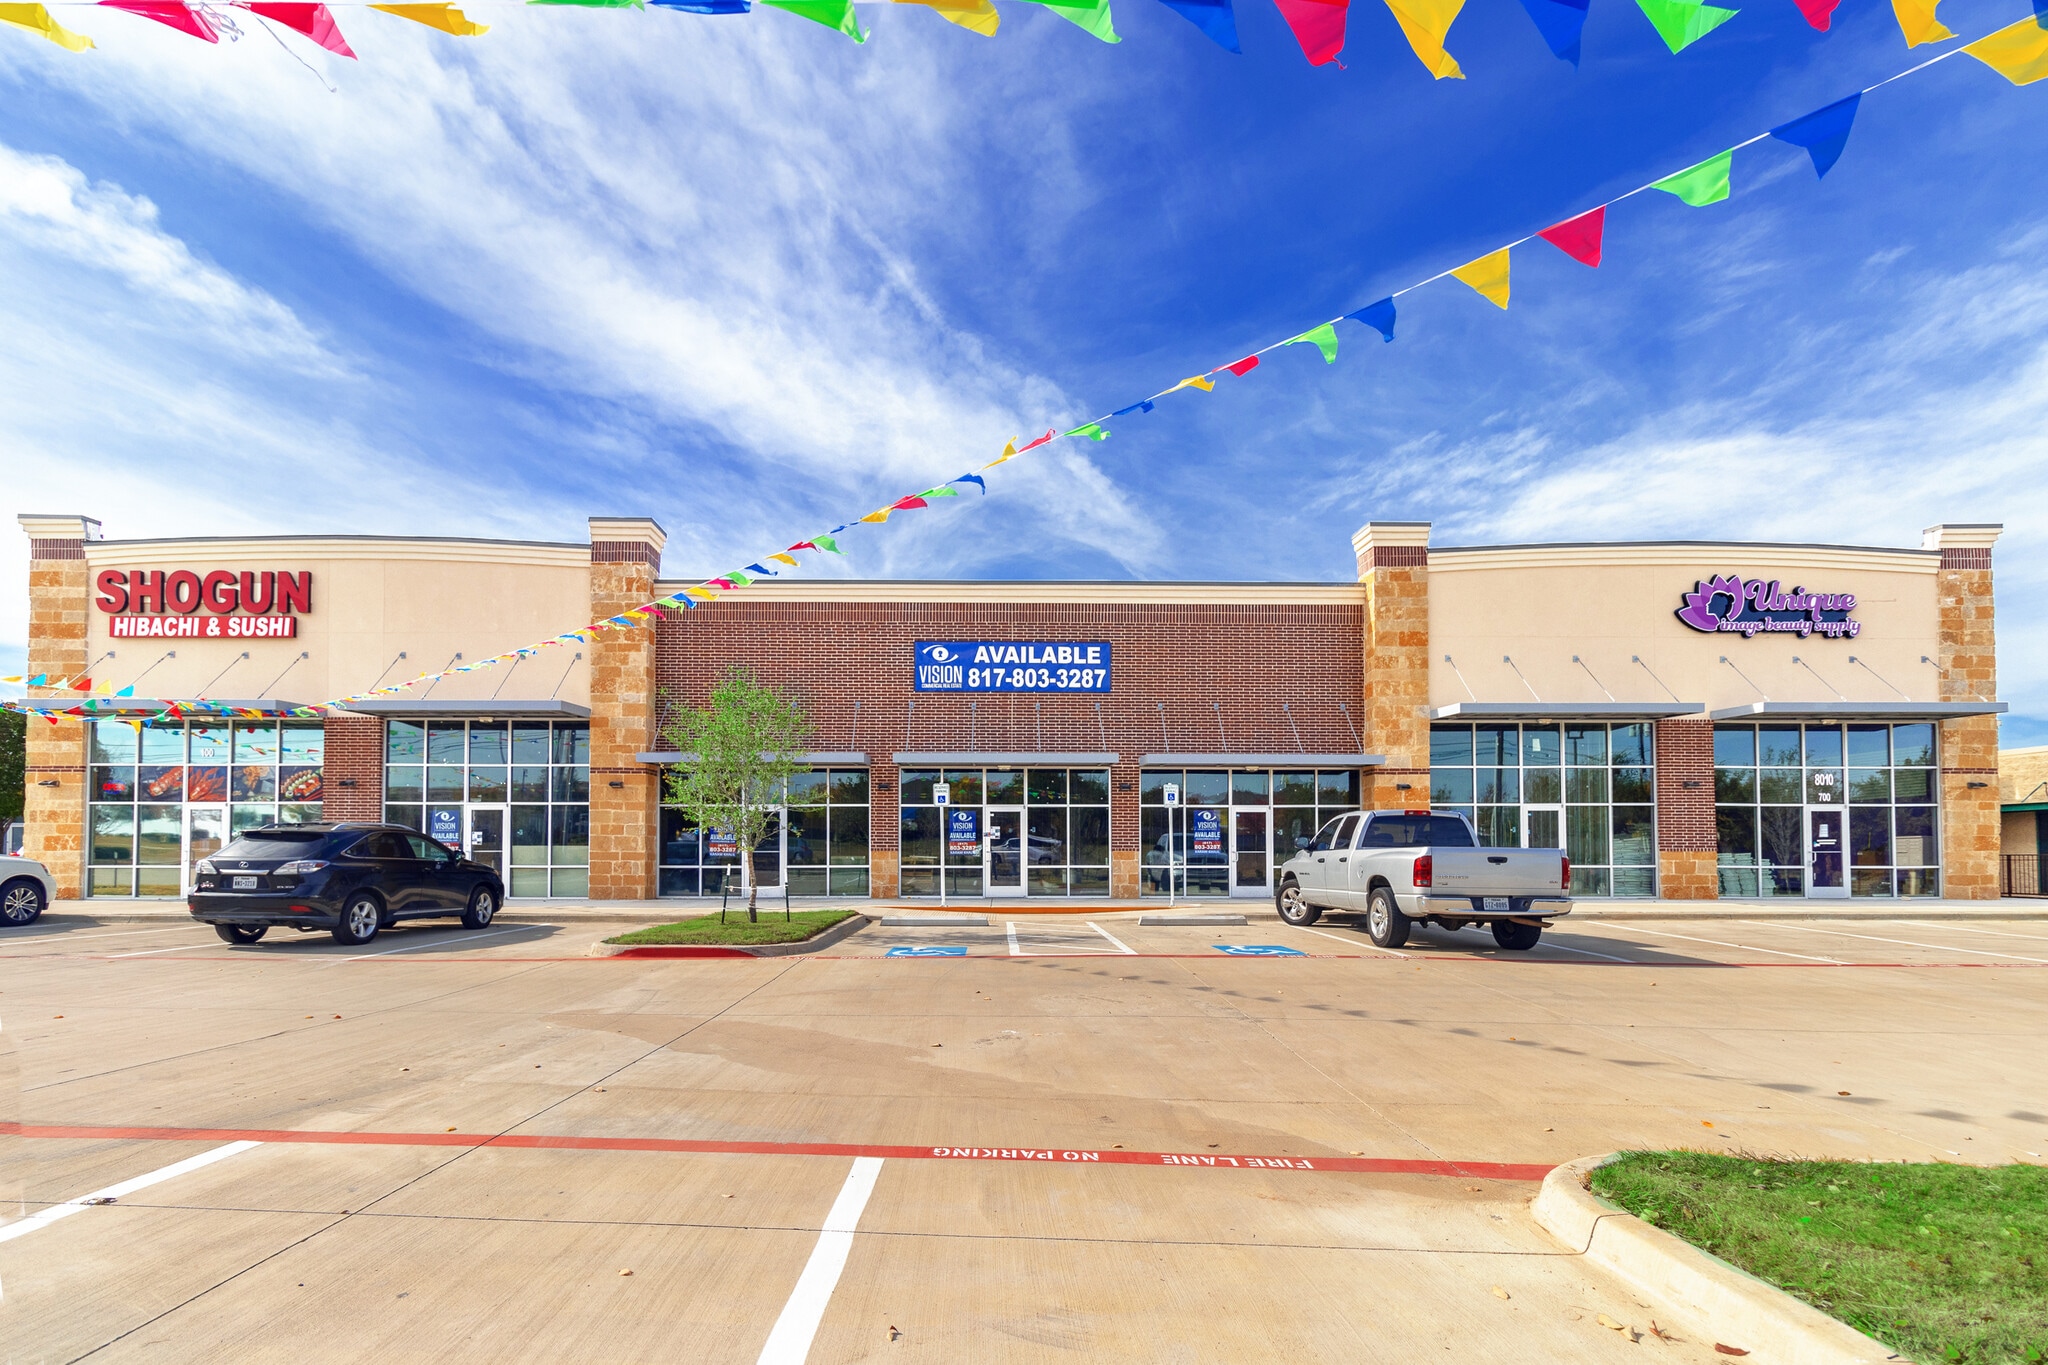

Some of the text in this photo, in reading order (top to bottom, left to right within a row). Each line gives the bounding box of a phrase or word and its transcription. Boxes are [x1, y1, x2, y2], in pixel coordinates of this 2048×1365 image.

[95, 569, 311, 614] SHOGUN
[1744, 579, 1857, 622] Unique
[113, 616, 291, 637] HIBACHI & SUSHI
[1719, 616, 1861, 638] image beauty supply
[973, 645, 1101, 664] AVAILABLE
[918, 665, 963, 683] VISION
[967, 667, 1107, 688] 817-803-3287
[202, 748, 214, 757] 100
[1814, 774, 1833, 785] 8010
[1818, 793, 1831, 801] 700
[933, 1147, 1099, 1161] NO PARKING
[1160, 1154, 1314, 1169] FIRE LANE
